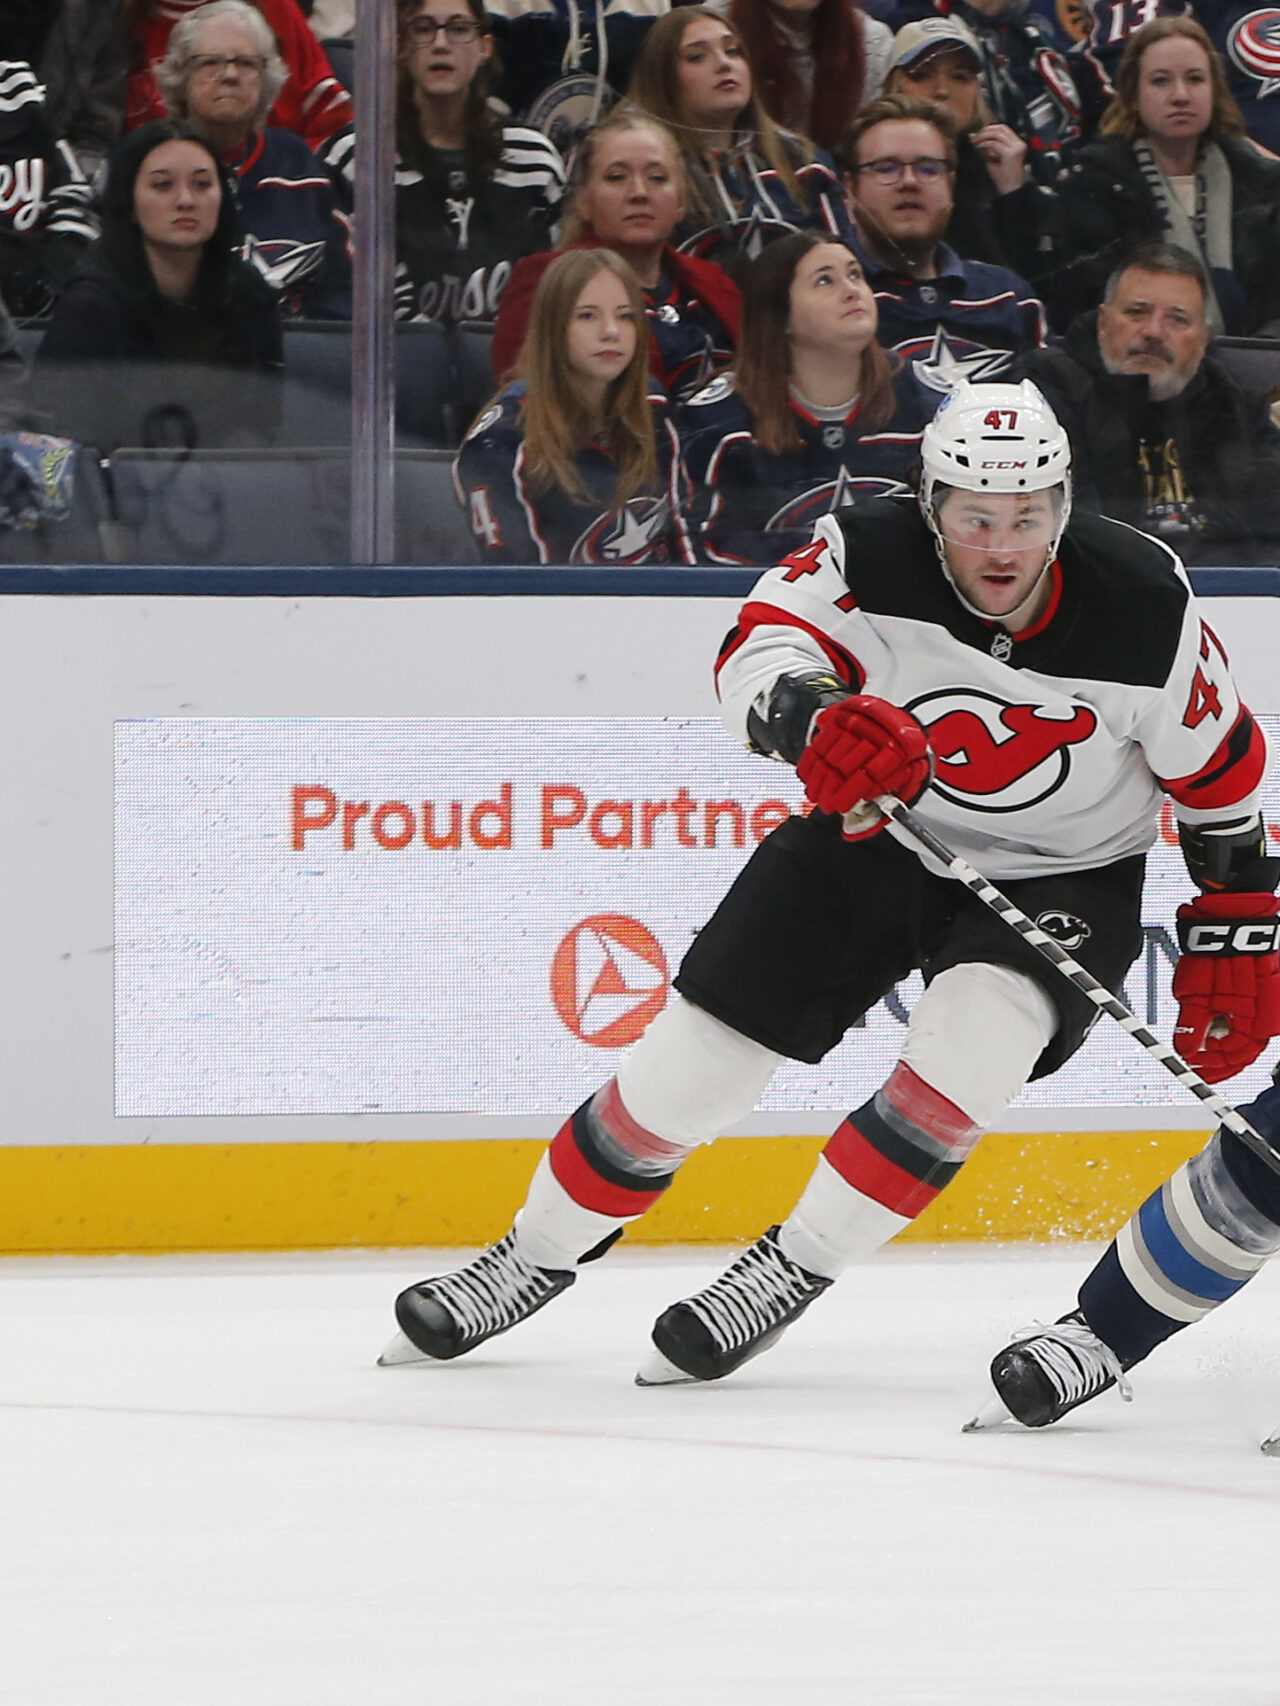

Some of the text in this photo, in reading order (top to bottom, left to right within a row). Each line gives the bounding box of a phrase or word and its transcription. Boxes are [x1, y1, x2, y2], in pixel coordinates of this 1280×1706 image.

[1107, 0, 1161, 44] 13
[983, 410, 1018, 430] 47
[981, 460, 1028, 470] CCM
[289, 783, 514, 851] Proud
